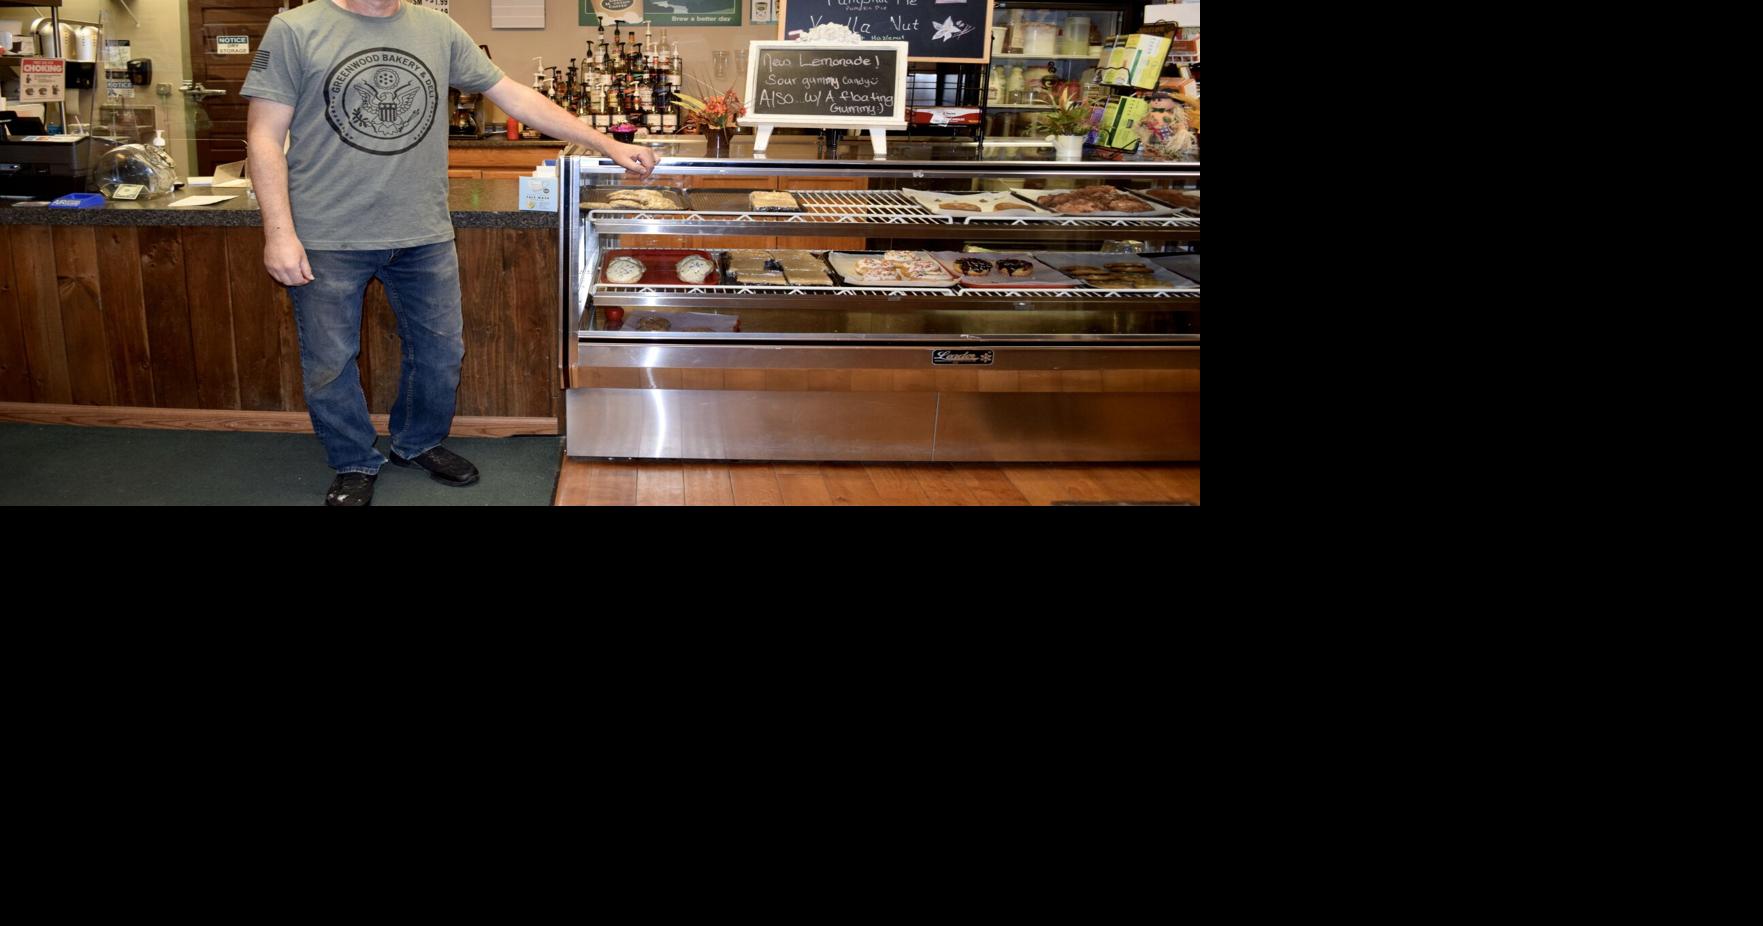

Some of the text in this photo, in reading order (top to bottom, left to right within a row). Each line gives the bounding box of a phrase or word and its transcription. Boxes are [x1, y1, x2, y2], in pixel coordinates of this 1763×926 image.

[810, 15, 920, 34] Vlla Nut
[23, 64, 63, 73] CHOKING
[331, 54, 380, 94] GREENWOOD
[382, 53, 421, 71] BAKERY
[425, 79, 434, 98] DELI
[765, 74, 796, 86] Sour
[801, 76, 840, 90] gummy
[825, 90, 835, 102] A
[839, 90, 894, 107] floating
